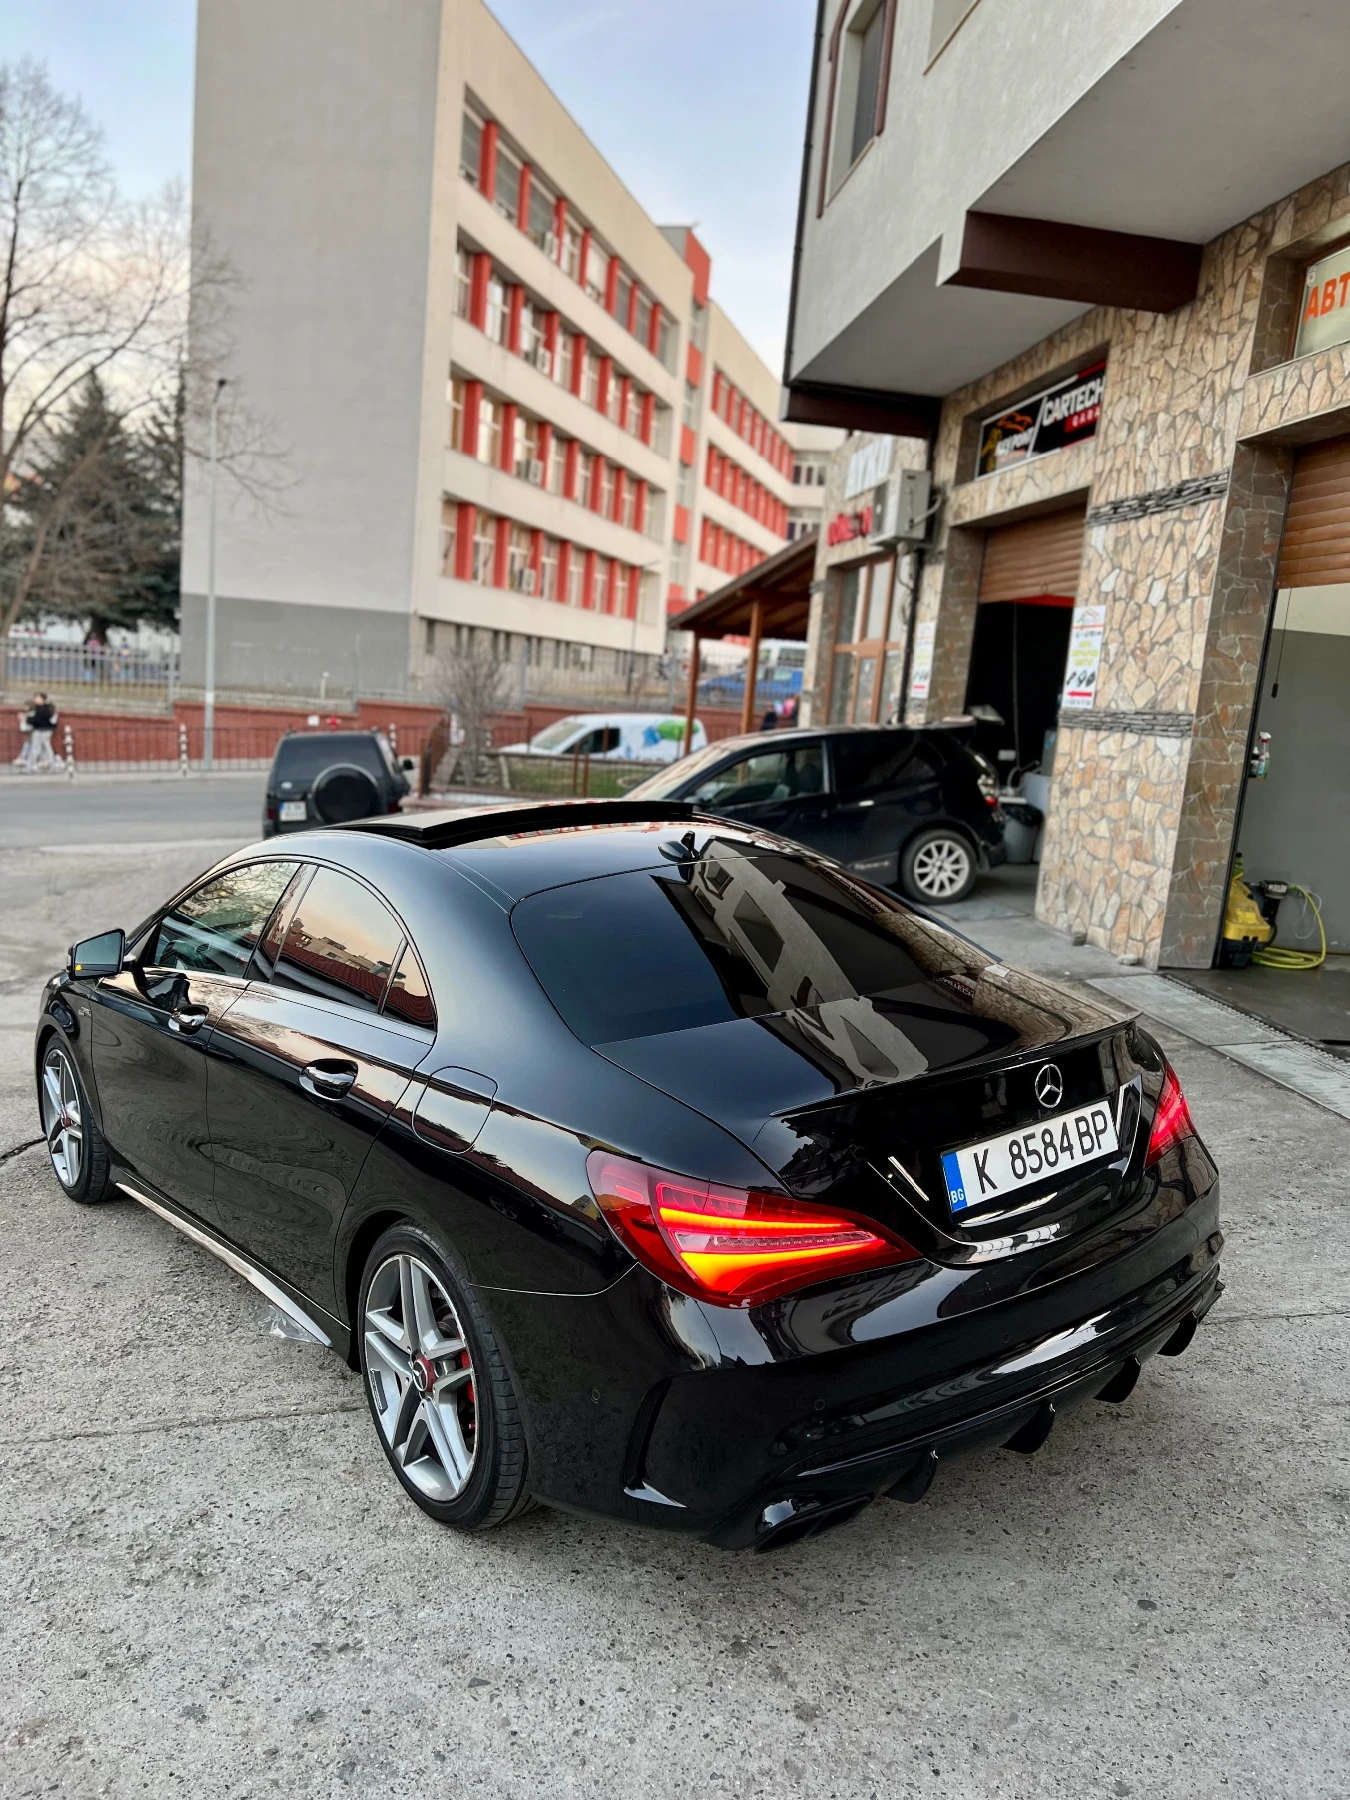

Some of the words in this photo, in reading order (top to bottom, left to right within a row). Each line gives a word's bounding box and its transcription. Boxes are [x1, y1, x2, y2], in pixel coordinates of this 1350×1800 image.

[1042, 376, 1106, 427] CARTECH
[973, 1148, 998, 1195] K
[950, 1188, 965, 1205] BG
